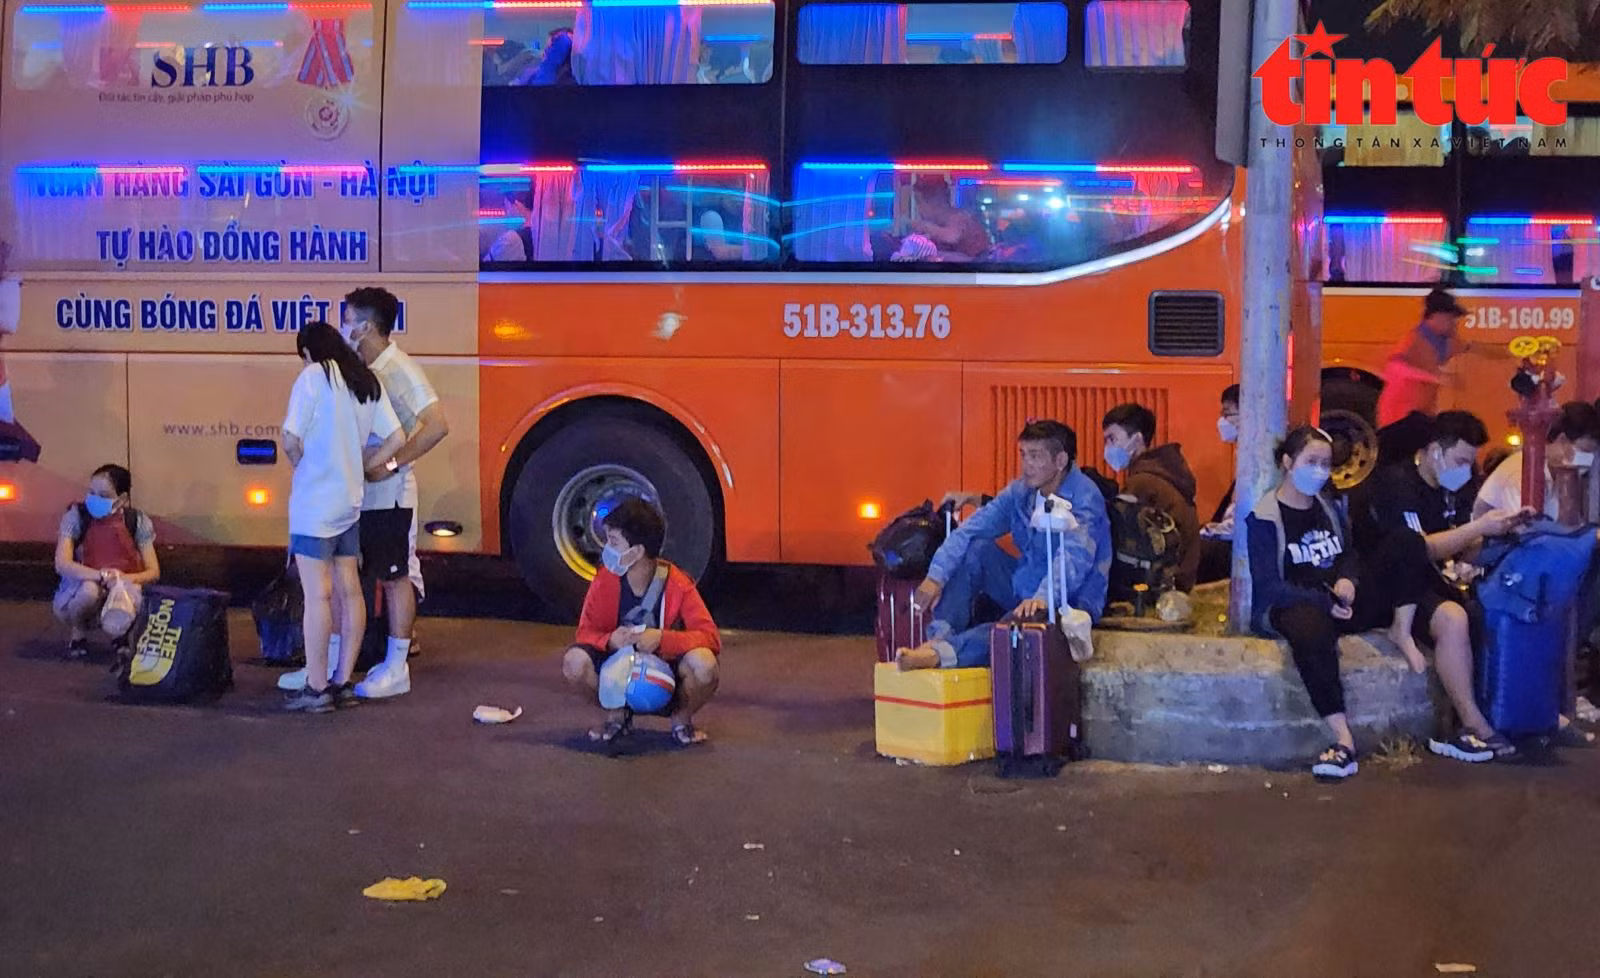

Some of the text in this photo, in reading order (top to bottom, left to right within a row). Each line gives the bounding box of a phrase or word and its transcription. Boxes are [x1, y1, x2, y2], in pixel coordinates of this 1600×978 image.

[152, 46, 255, 88] SHB
[114, 161, 189, 197] HÀNG
[199, 160, 244, 197] SÀI
[255, 159, 313, 197] GÒN
[341, 160, 377, 197] HÀ
[387, 160, 436, 203] NỘI
[96, 219, 367, 267] TỰ HÀO ĐỒNG HÀNH
[56, 293, 131, 329] CÙNG
[141, 292, 216, 329] BÓNG
[226, 294, 262, 330] ĐÁ
[783, 303, 951, 338] 51B-313.76
[145, 599, 175, 657] NORTH
[161, 626, 182, 660] THE
